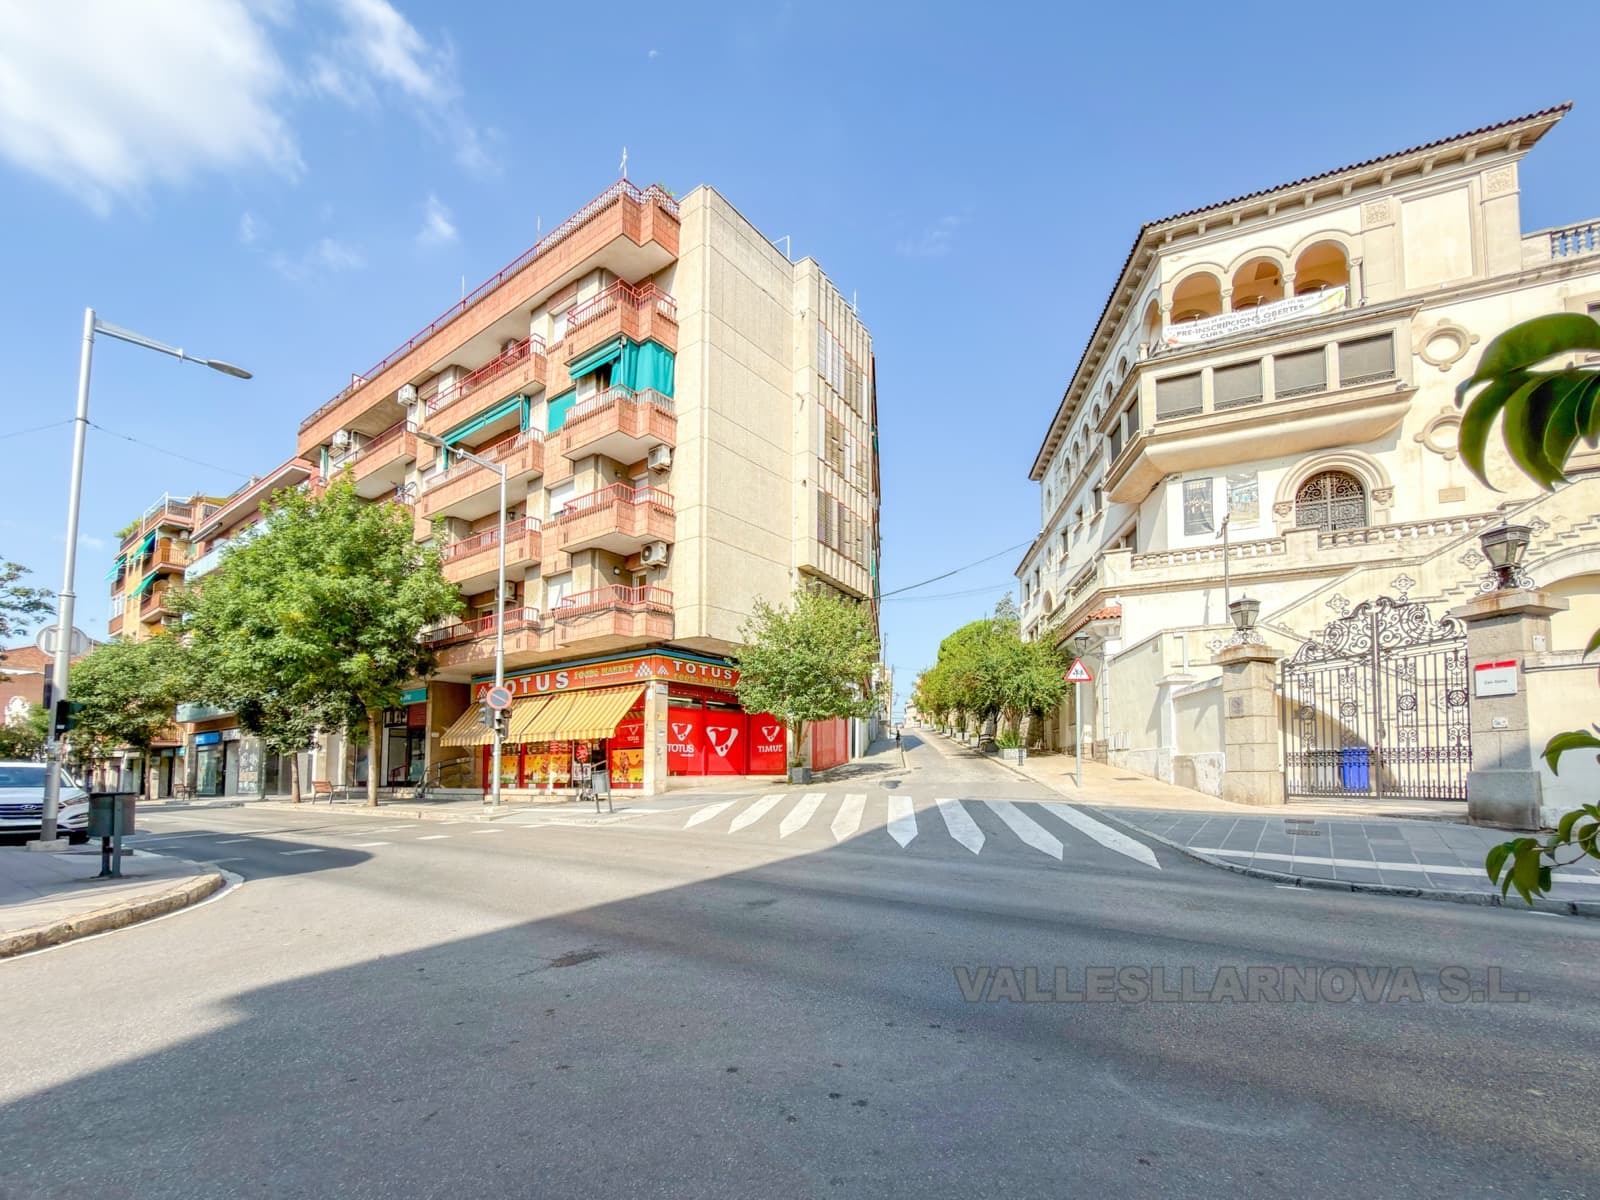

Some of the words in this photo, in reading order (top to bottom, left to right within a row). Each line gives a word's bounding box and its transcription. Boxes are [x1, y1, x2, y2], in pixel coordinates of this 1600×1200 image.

[1263, 304, 1305, 319] OBERTES
[672, 660, 732, 680] TOTUS
[666, 743, 695, 753] TOTUS
